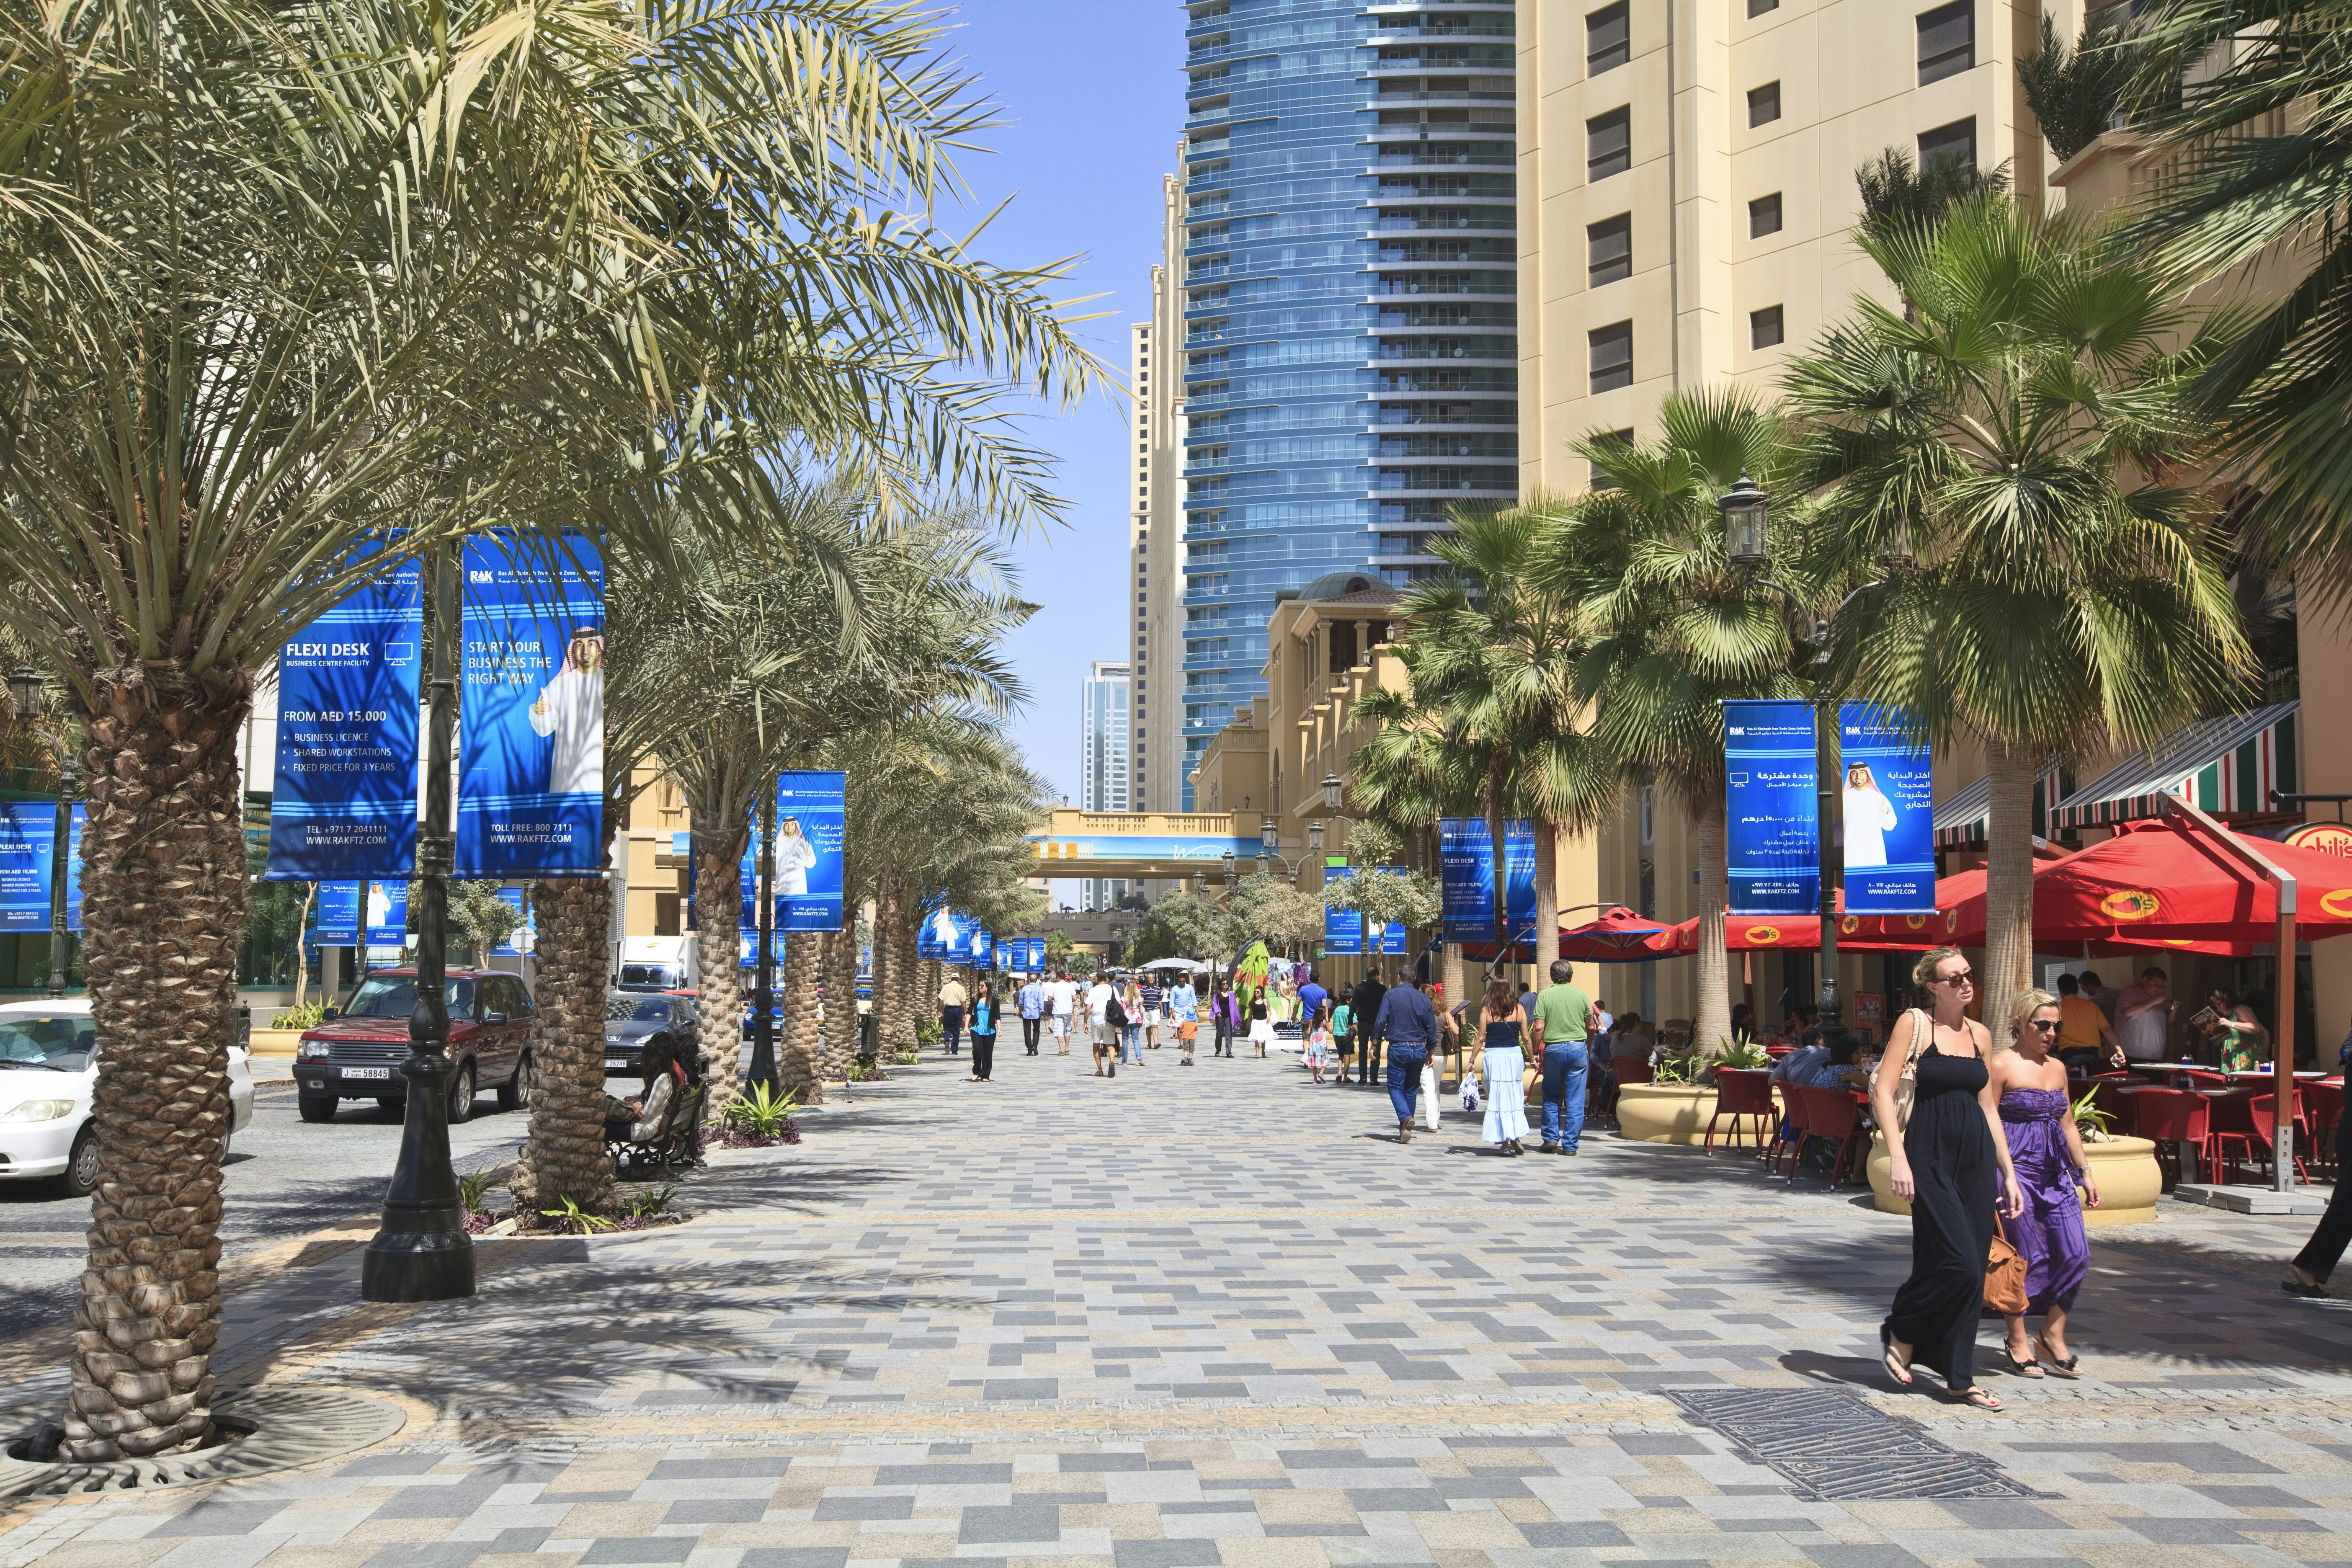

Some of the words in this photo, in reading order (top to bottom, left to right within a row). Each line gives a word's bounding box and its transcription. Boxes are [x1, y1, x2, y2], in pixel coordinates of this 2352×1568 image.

[286, 643, 326, 656] FLEXI
[332, 643, 370, 656] DESK
[507, 642, 540, 652] YOUR
[529, 657, 552, 668] THE
[468, 673, 504, 684] RIGHT
[507, 673, 534, 684] WAY
[284, 711, 316, 722] FROM
[320, 711, 344, 722] AED
[348, 711, 386, 722] 15,000
[1846, 726, 1861, 735] RAK
[329, 748, 391, 756] WORKSTATIONS
[293, 763, 317, 772] FIXED
[369, 763, 395, 771] YEARS
[1757, 771, 1791, 780] مشتركة
[1914, 771, 1930, 780] اختر
[1894, 791, 1930, 799] لمشروعك
[1905, 800, 1931, 810] التجاري
[364, 1069, 387, 1078] 58845
